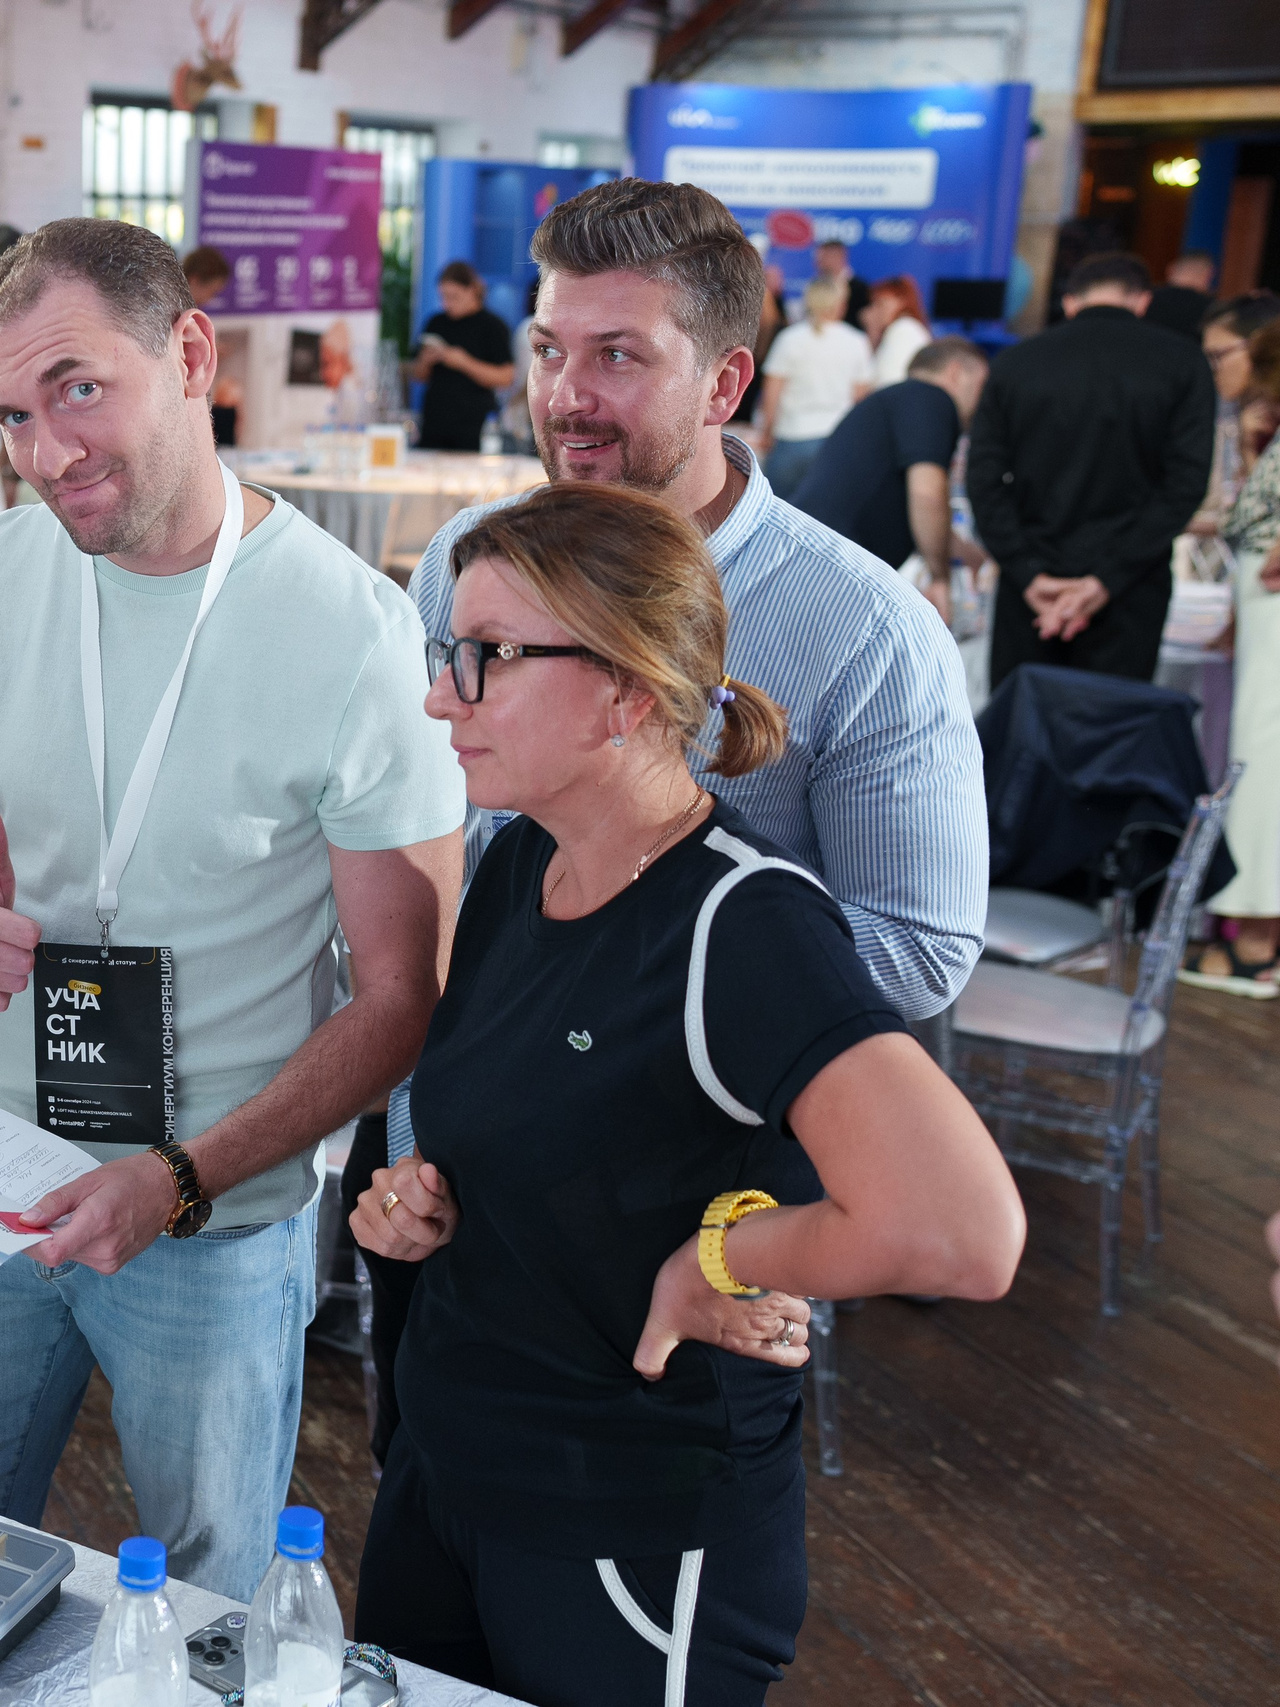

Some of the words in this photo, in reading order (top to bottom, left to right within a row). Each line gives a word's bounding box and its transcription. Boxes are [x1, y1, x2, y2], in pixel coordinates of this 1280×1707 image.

[44, 986, 101, 1011] УЧА
[73, 982, 96, 993] бизнес
[160, 948, 173, 1055] КОНФЕРЕНЦИЯ
[46, 1013, 81, 1036] СТ
[47, 1040, 106, 1064] НИК
[163, 1058, 175, 1141] СИНЕРГИУМ
